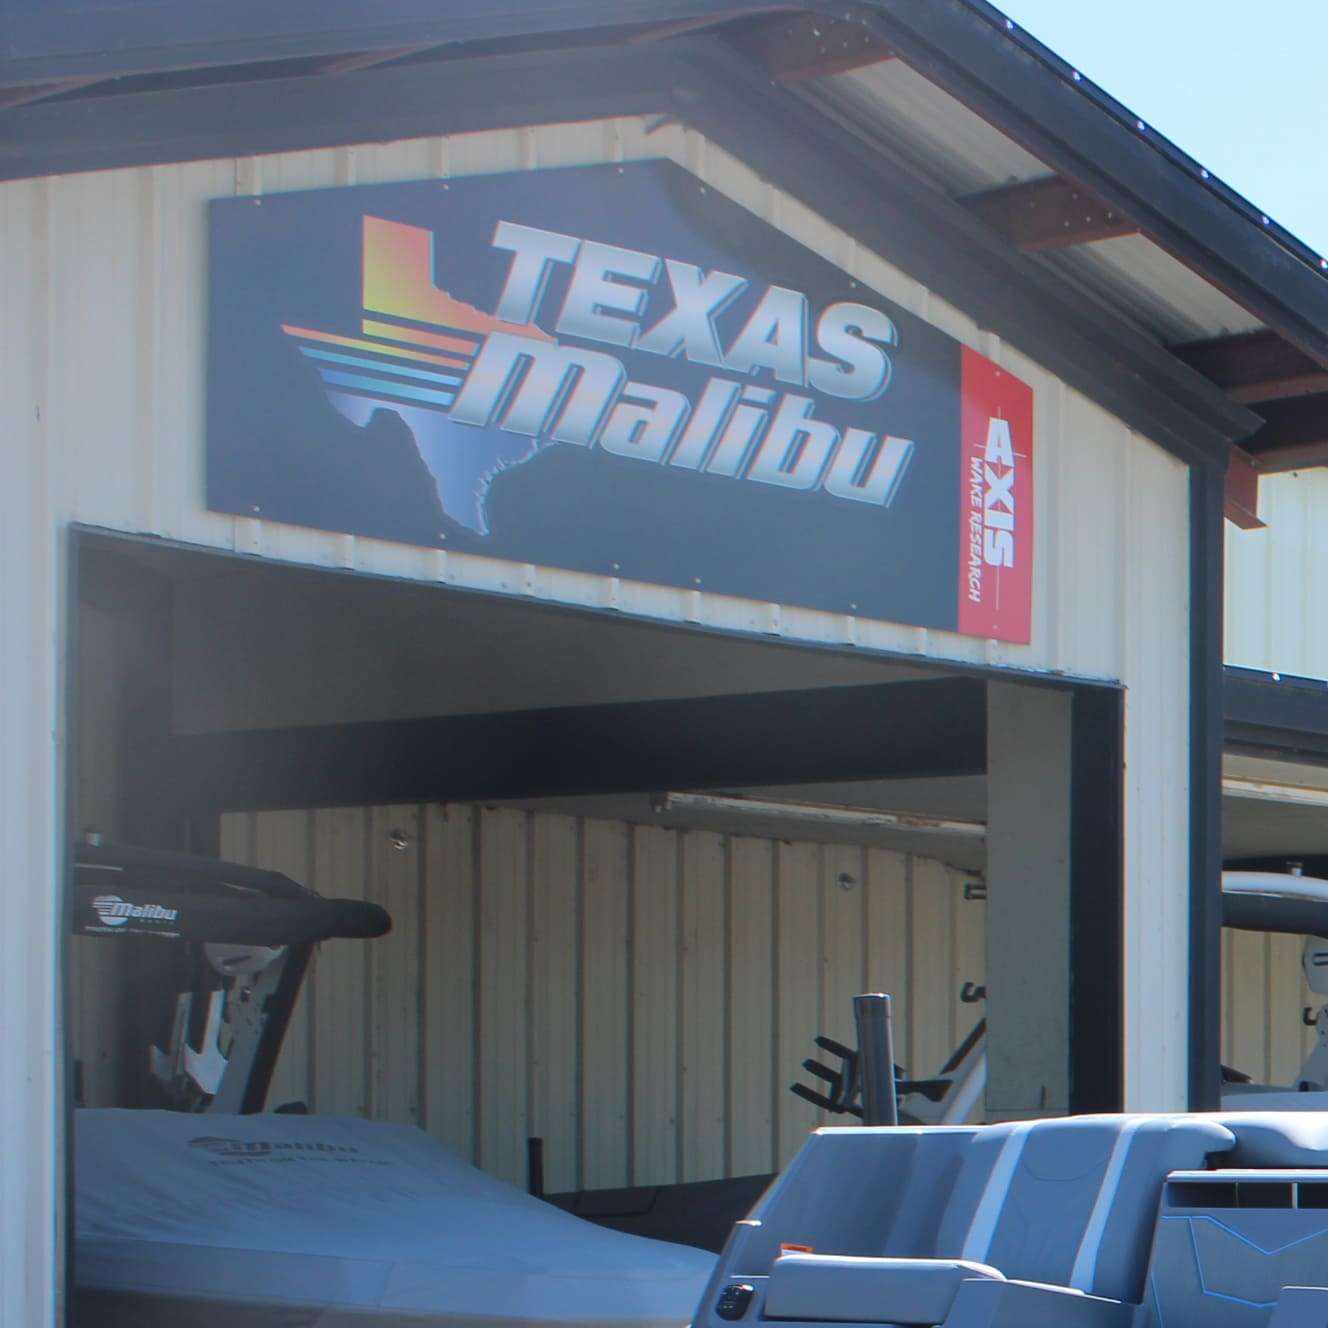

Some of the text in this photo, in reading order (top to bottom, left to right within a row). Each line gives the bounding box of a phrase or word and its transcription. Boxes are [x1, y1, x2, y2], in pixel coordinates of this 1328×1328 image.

[492, 220, 898, 402] TEXAS
[447, 330, 915, 508] Malibu
[984, 416, 1015, 568] AXIS
[967, 456, 984, 603] WAKE RESEARCH
